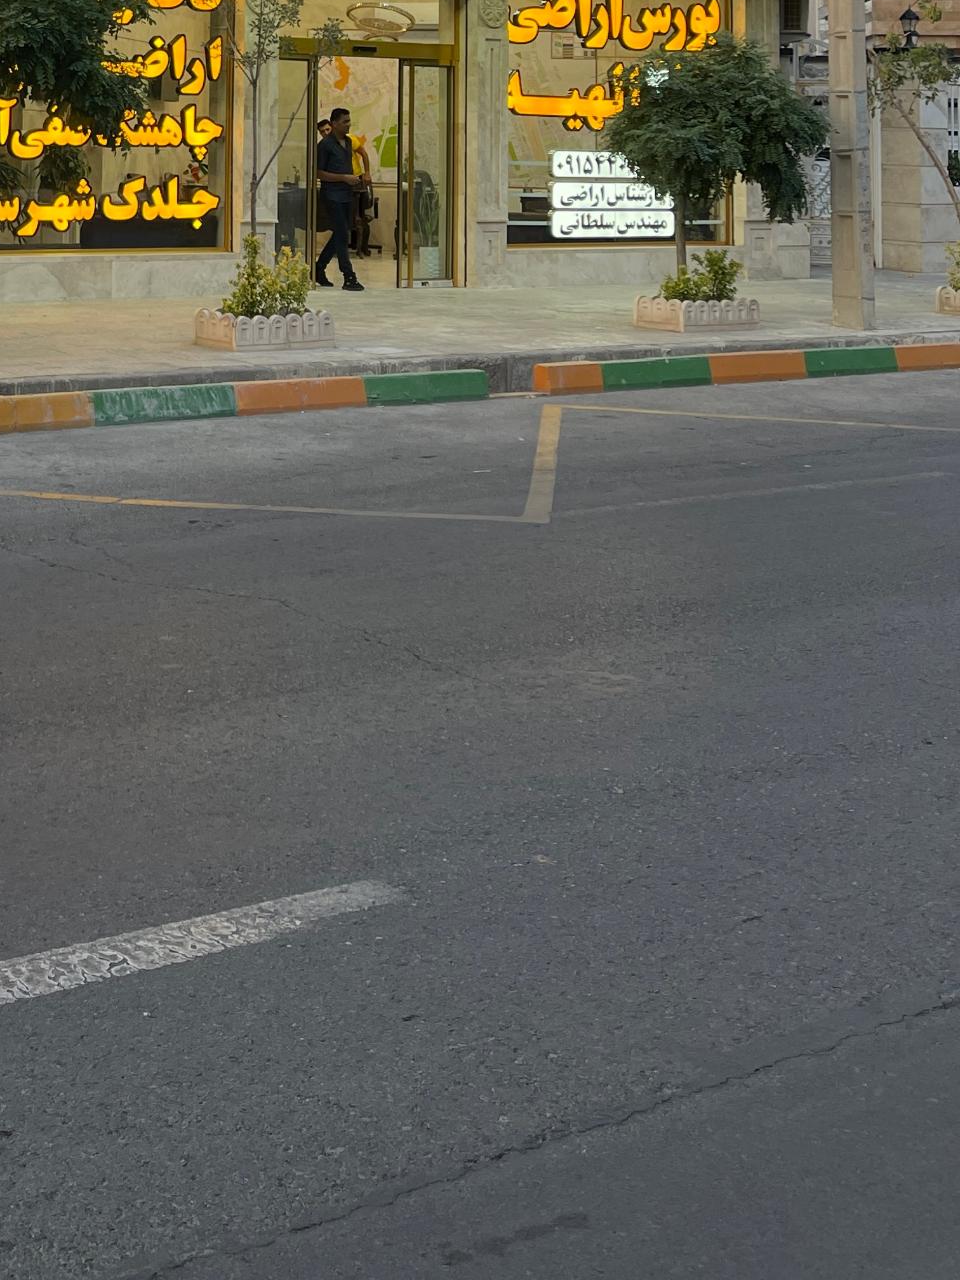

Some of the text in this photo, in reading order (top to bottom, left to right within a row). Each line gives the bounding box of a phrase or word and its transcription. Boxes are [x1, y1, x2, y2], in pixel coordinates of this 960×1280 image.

[16, 178, 97, 236] شهر
[102, 177, 221, 231] جلدک
[560, 185, 605, 207] اراضی
[560, 212, 669, 235] مهندس سلطانی
